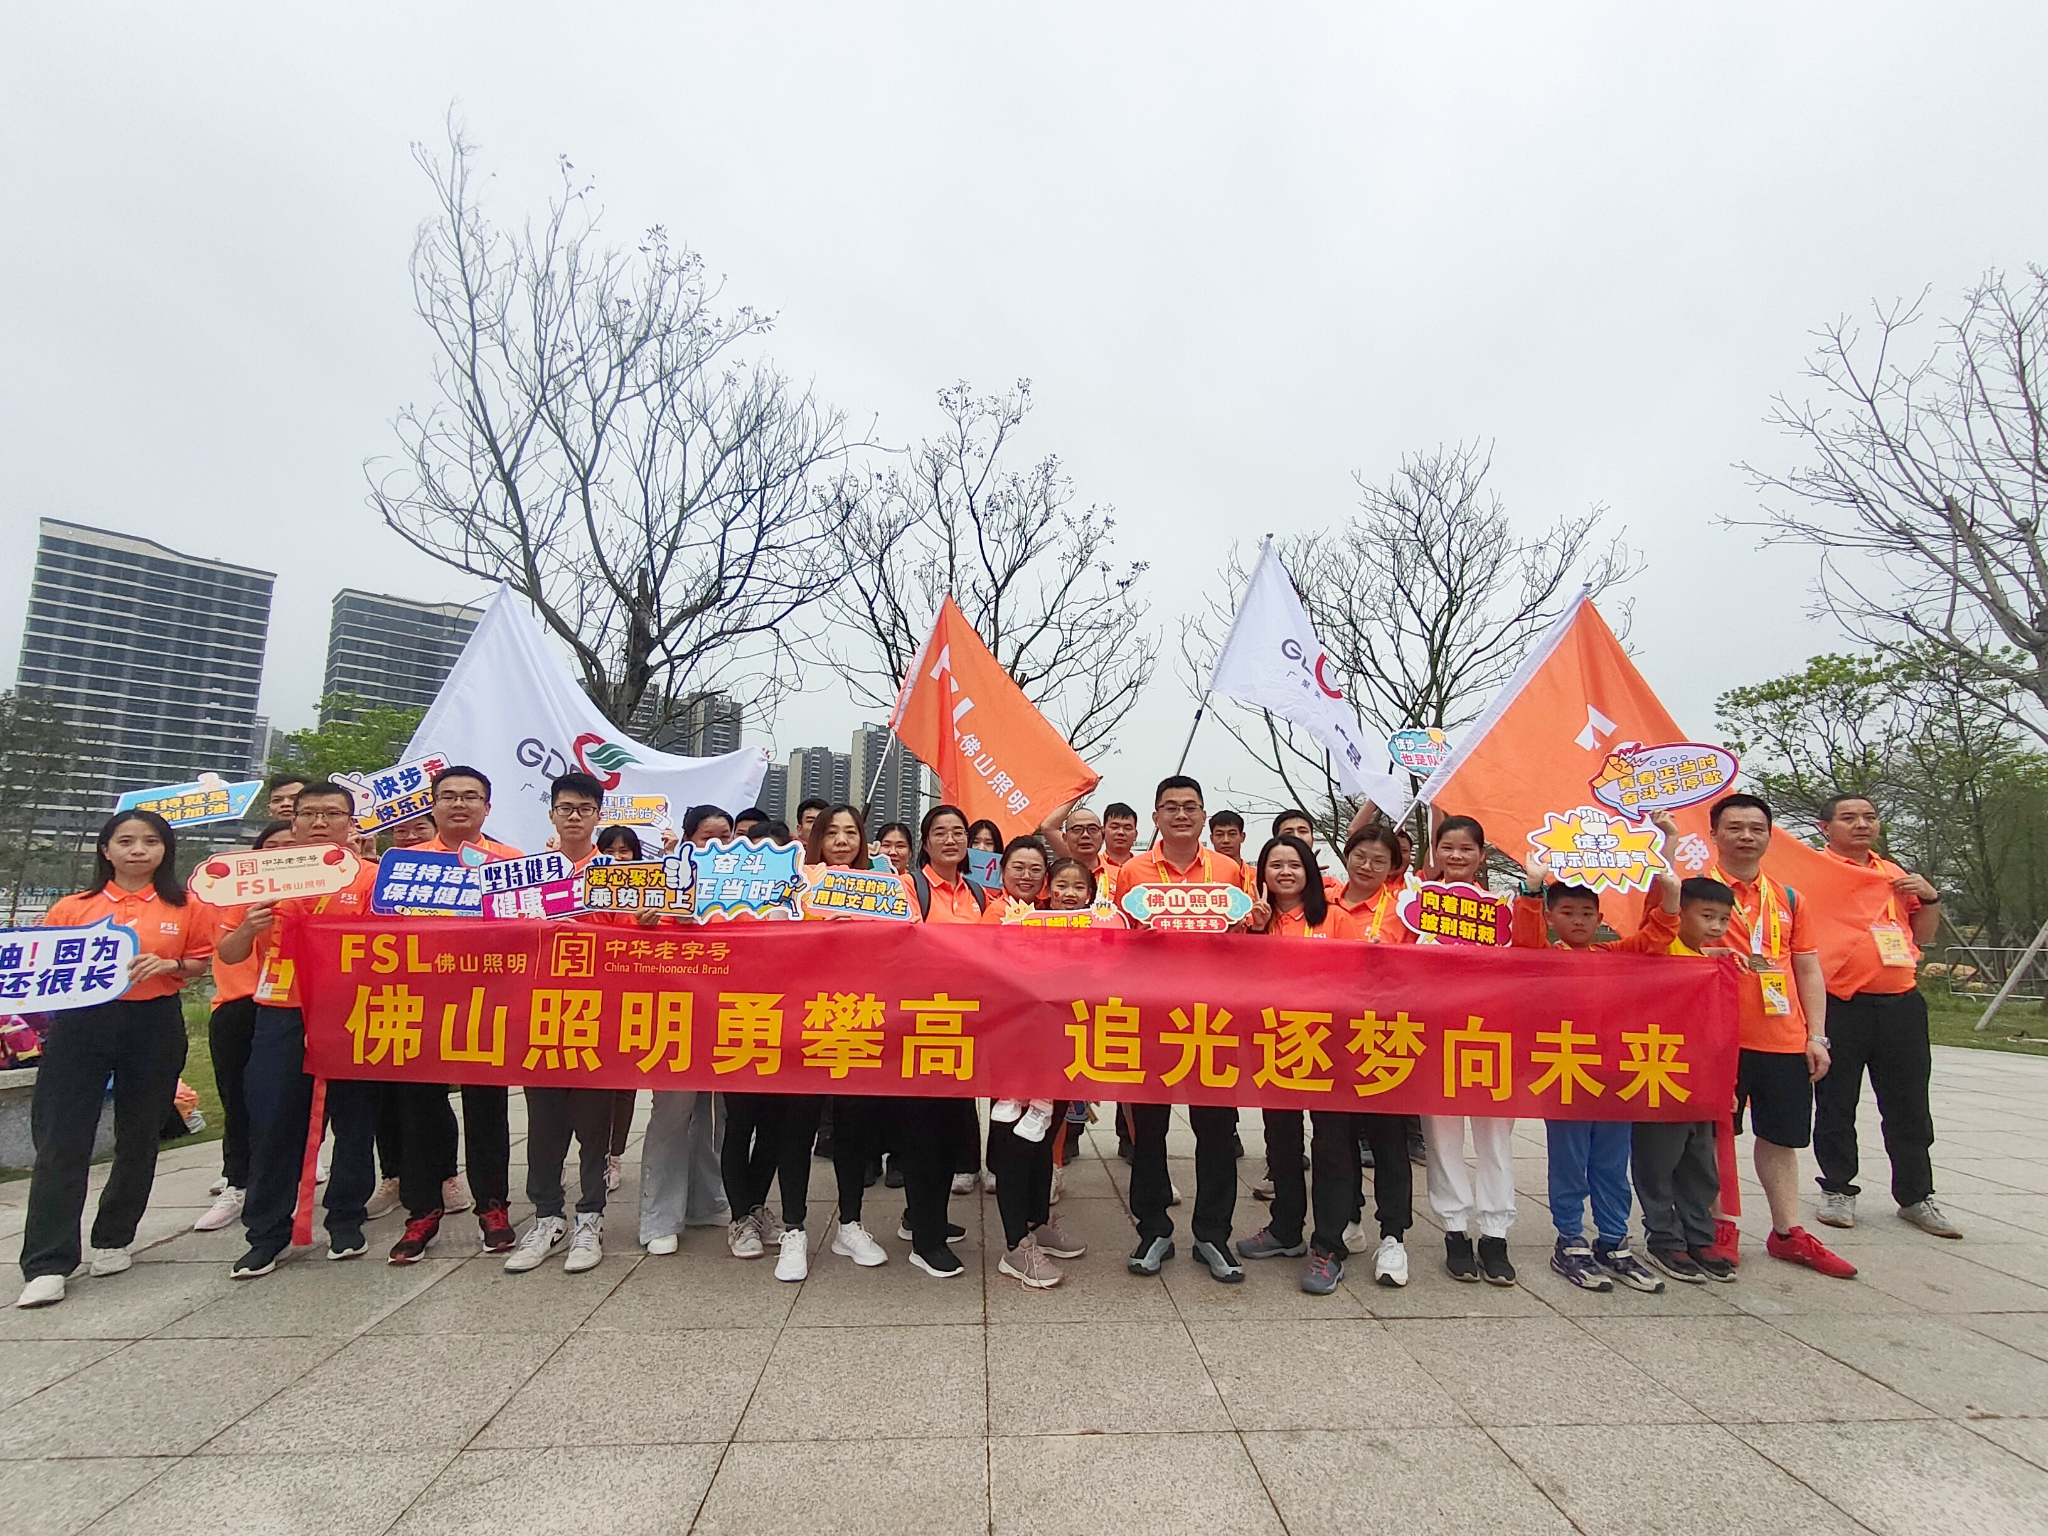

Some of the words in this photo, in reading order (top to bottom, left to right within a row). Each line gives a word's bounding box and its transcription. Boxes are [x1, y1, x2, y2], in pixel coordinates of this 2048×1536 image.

[958, 733, 1031, 816] 佛山照明
[1617, 754, 1717, 791] 青春正当时
[1620, 770, 1724, 807] 奋斗不停歇
[1572, 834, 1620, 850] 徒步
[1674, 832, 1711, 871] 佛
[261, 855, 319, 867] 中华老字号
[712, 853, 766, 875] 奋斗
[1550, 851, 1649, 869] 展示你的勇气
[282, 879, 326, 892] 佛山照明
[484, 855, 564, 893] 坚持健身
[588, 868, 666, 888] 凝心聚力
[823, 874, 897, 897] 做个行走的诗人
[236, 878, 281, 897] FSL
[381, 882, 481, 907] 保持健康
[589, 887, 692, 910] 乘势而上
[698, 878, 775, 902] 正当时
[814, 889, 909, 916] 用脚丈量人生
[1146, 893, 1229, 908] 佛山照明
[1422, 891, 1496, 923] 向着阳光
[160, 922, 179, 930] FSL
[1159, 918, 1220, 931] 中华老字号
[1420, 912, 1496, 945] 披荆斩棘
[340, 934, 432, 973] FSL
[605, 939, 731, 961] 中华老字号
[435, 953, 528, 974] 佛山照明
[604, 962, 630, 973] China
[701, 964, 730, 975] Brand
[0, 964, 118, 999] 还很长
[344, 983, 980, 1081] 佛山照明勇攀高
[1063, 996, 1692, 1108] 追光逐梦向未来
